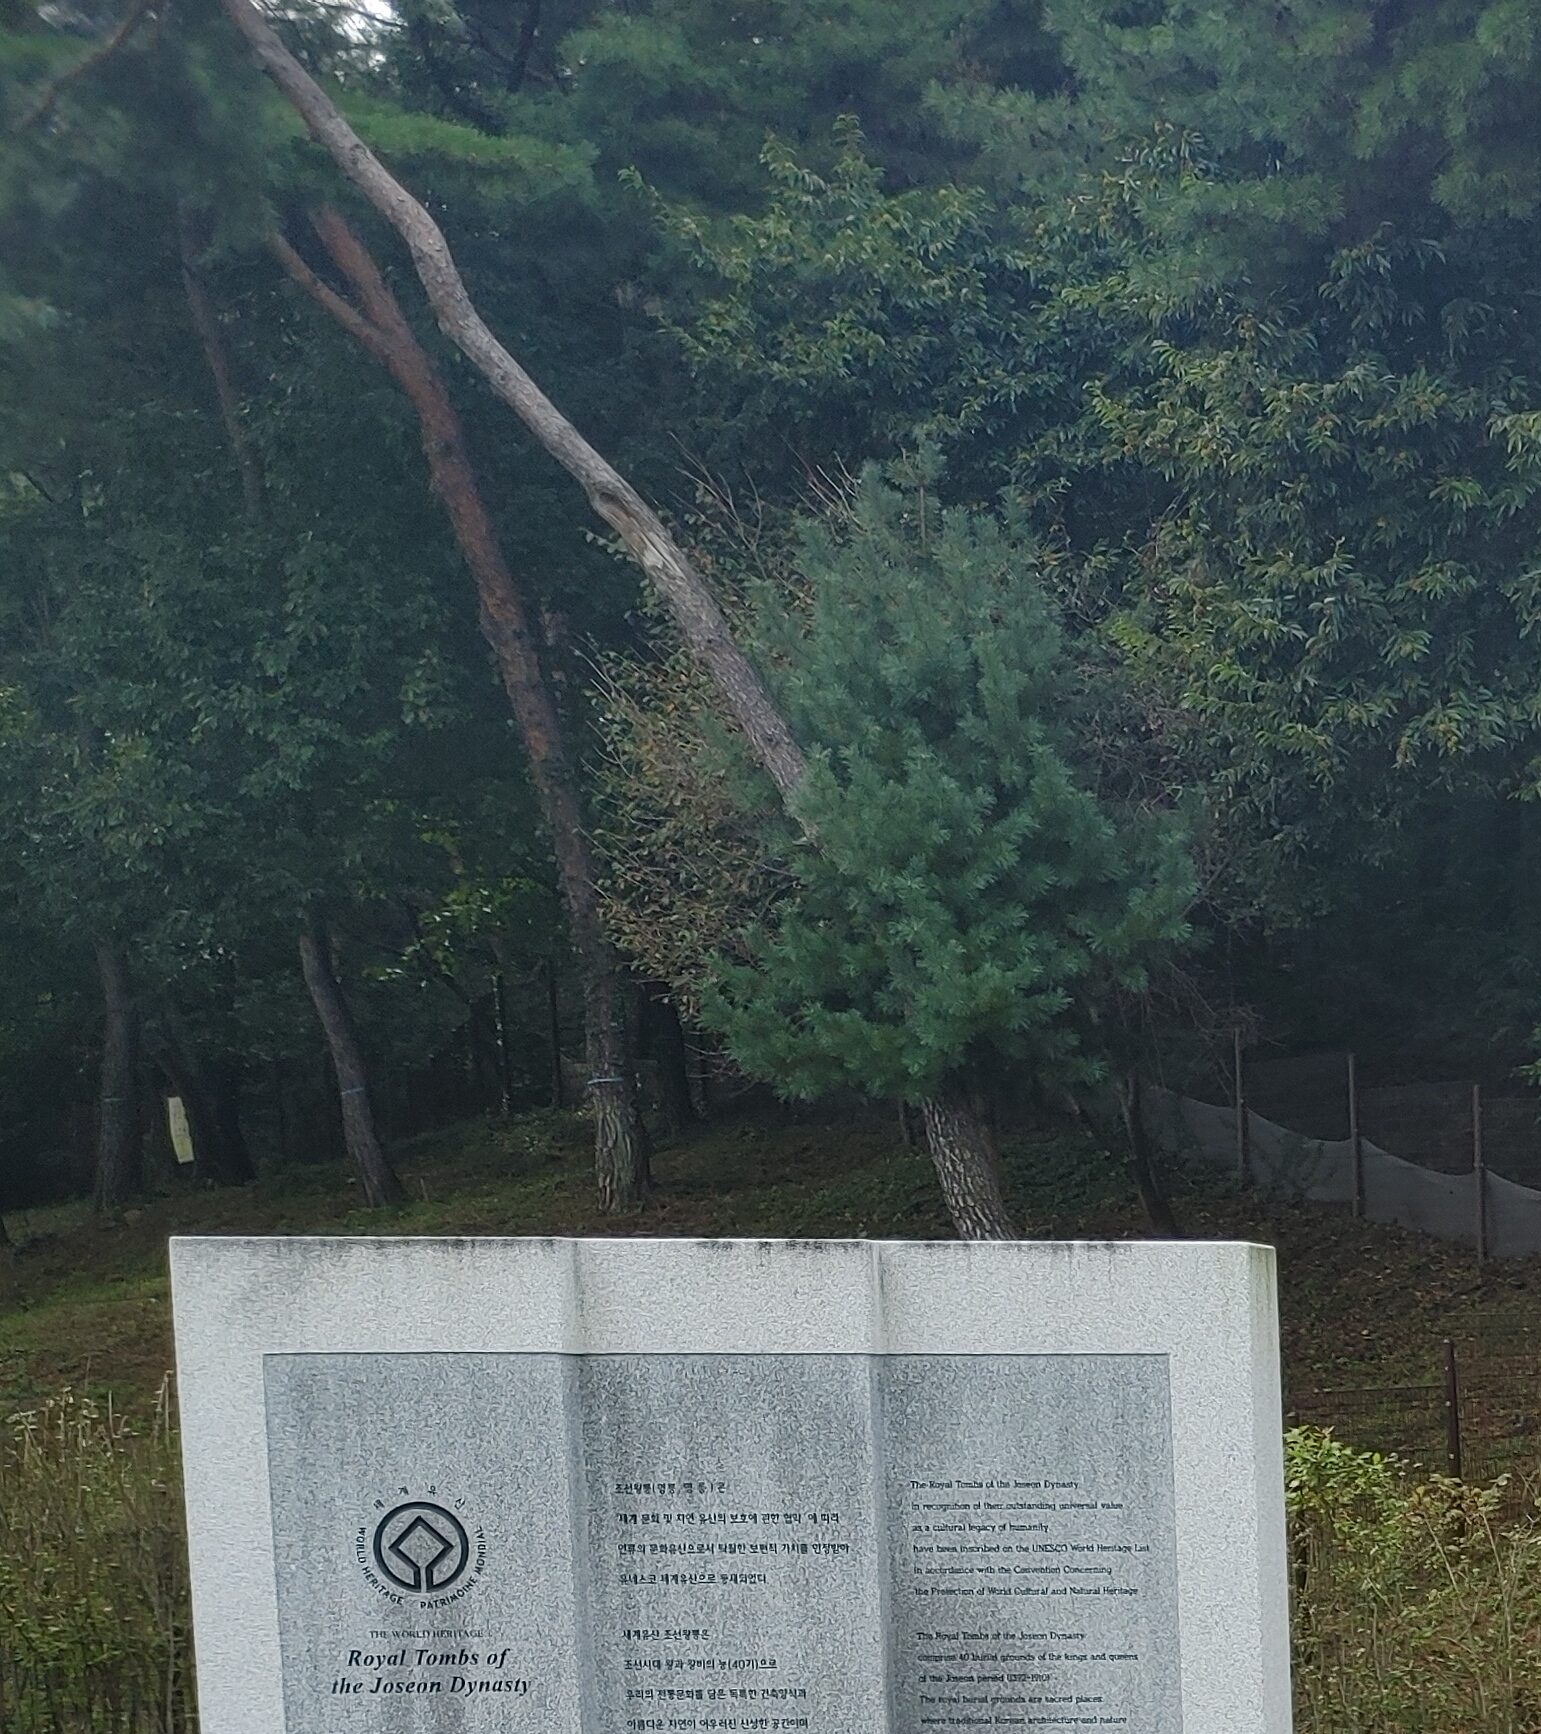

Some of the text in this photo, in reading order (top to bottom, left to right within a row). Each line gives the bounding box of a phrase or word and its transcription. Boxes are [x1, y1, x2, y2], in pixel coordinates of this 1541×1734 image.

[354, 1526, 405, 1606] WORLD HERITAGE
[420, 1525, 487, 1610] PATRIMOINE MONDIAL
[369, 1629, 484, 1639] THE WORLD HERITAGE
[347, 1648, 511, 1671] Royal Tombs of
[331, 1675, 532, 1698] the Joseon Dynasty
